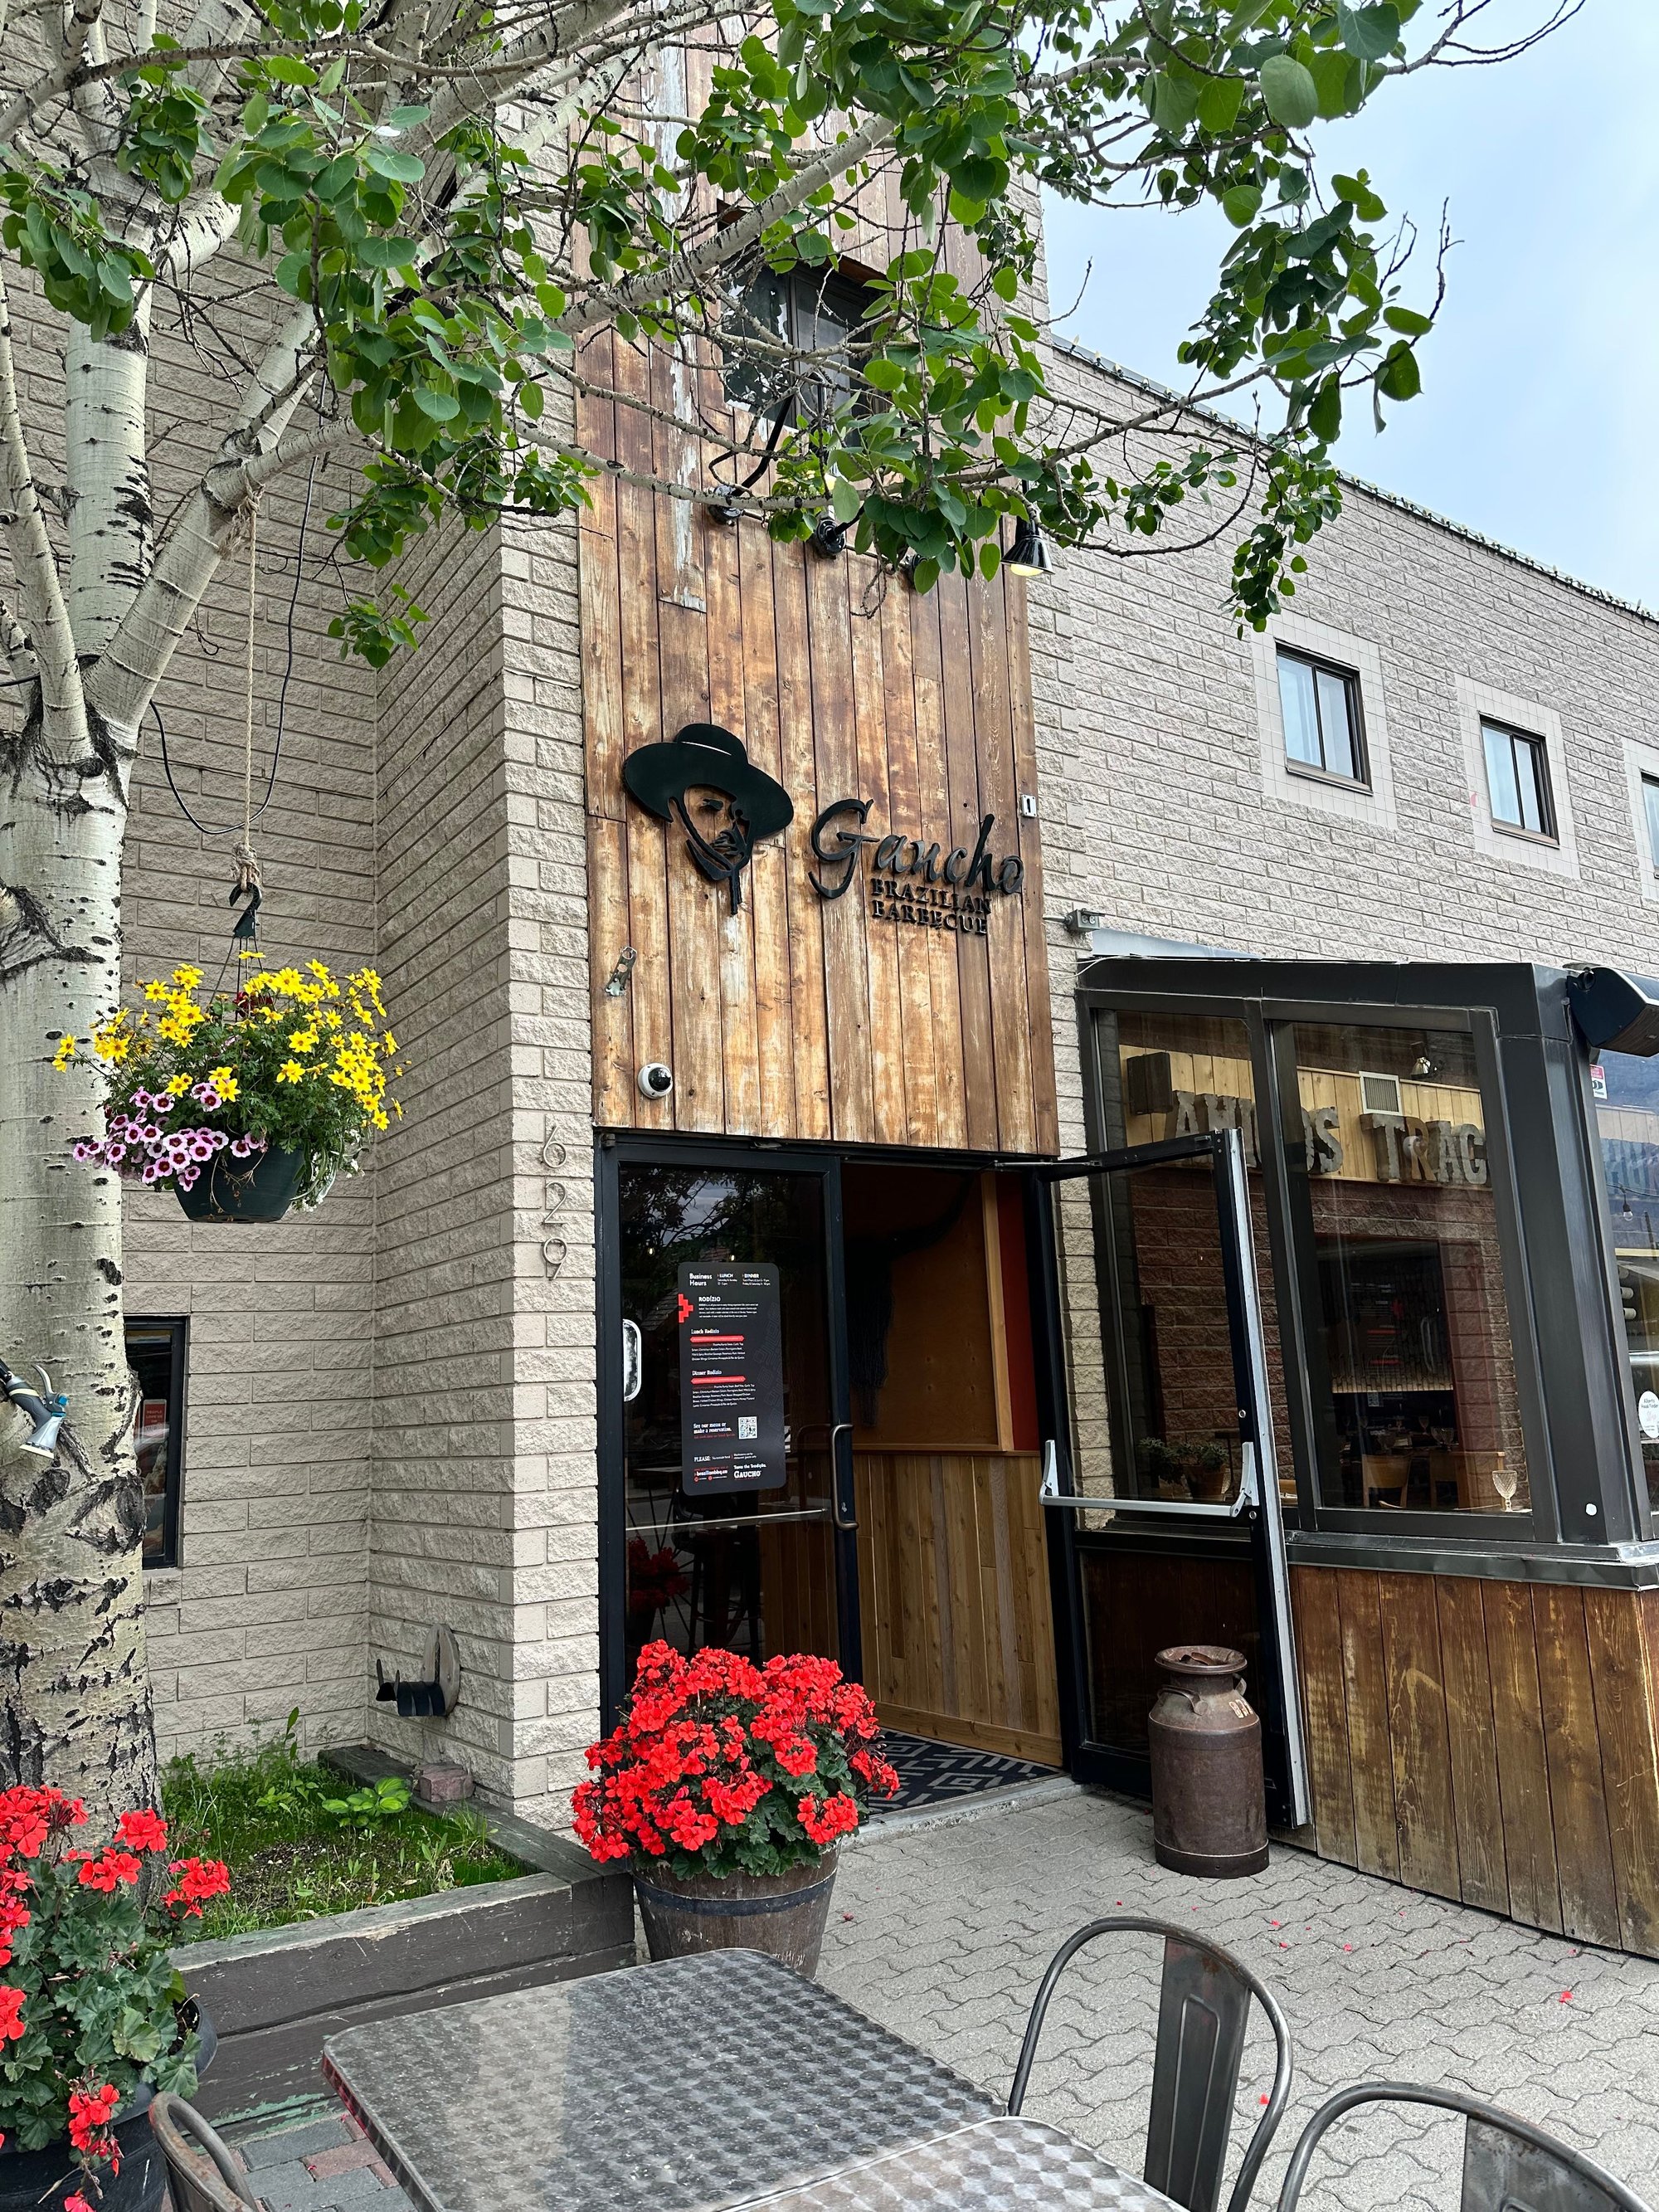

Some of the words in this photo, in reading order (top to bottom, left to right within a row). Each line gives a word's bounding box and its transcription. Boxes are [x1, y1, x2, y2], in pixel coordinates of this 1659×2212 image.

[808, 799, 1024, 899] Gaucho
[871, 877, 992, 914] BRAZILIAN
[872, 899, 988, 936] BARBECUE
[543, 1125, 569, 1280] 629
